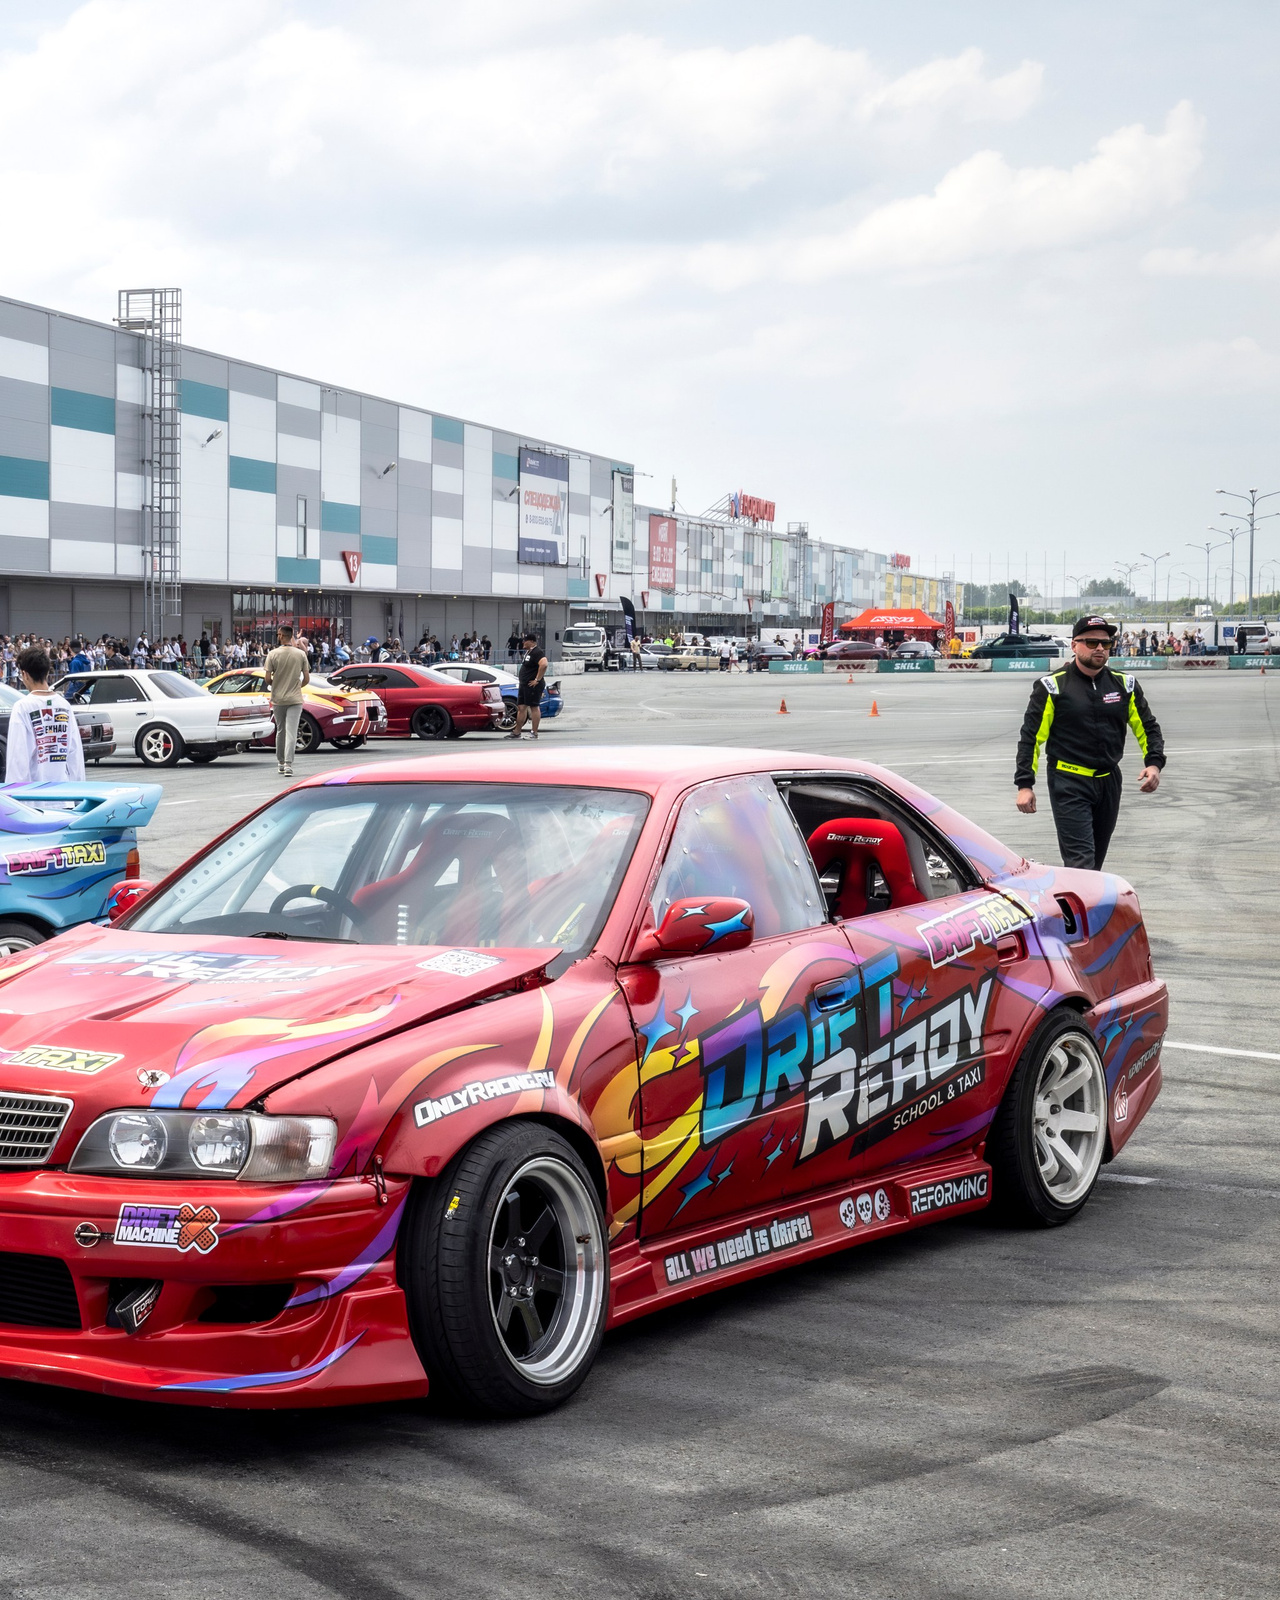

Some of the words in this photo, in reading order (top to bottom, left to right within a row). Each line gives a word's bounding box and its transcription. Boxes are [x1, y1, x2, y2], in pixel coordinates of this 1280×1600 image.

[350, 554, 358, 572] 13
[783, 663, 809, 671] SKILL
[894, 662, 921, 670] SKILL
[1008, 661, 1036, 669] SKILL
[827, 833, 854, 841] DRIFT
[854, 835, 883, 844] READY
[702, 952, 900, 1145] DRIFT
[799, 977, 993, 1160] READY
[893, 1094, 944, 1131] SCHOOL
[947, 1085, 955, 1099] &
[957, 1066, 982, 1094] TAXI
[121, 1207, 180, 1229] DRIFT
[118, 1226, 180, 1243] MACHINE
[718, 1228, 755, 1265] need
[755, 1229, 770, 1252] is
